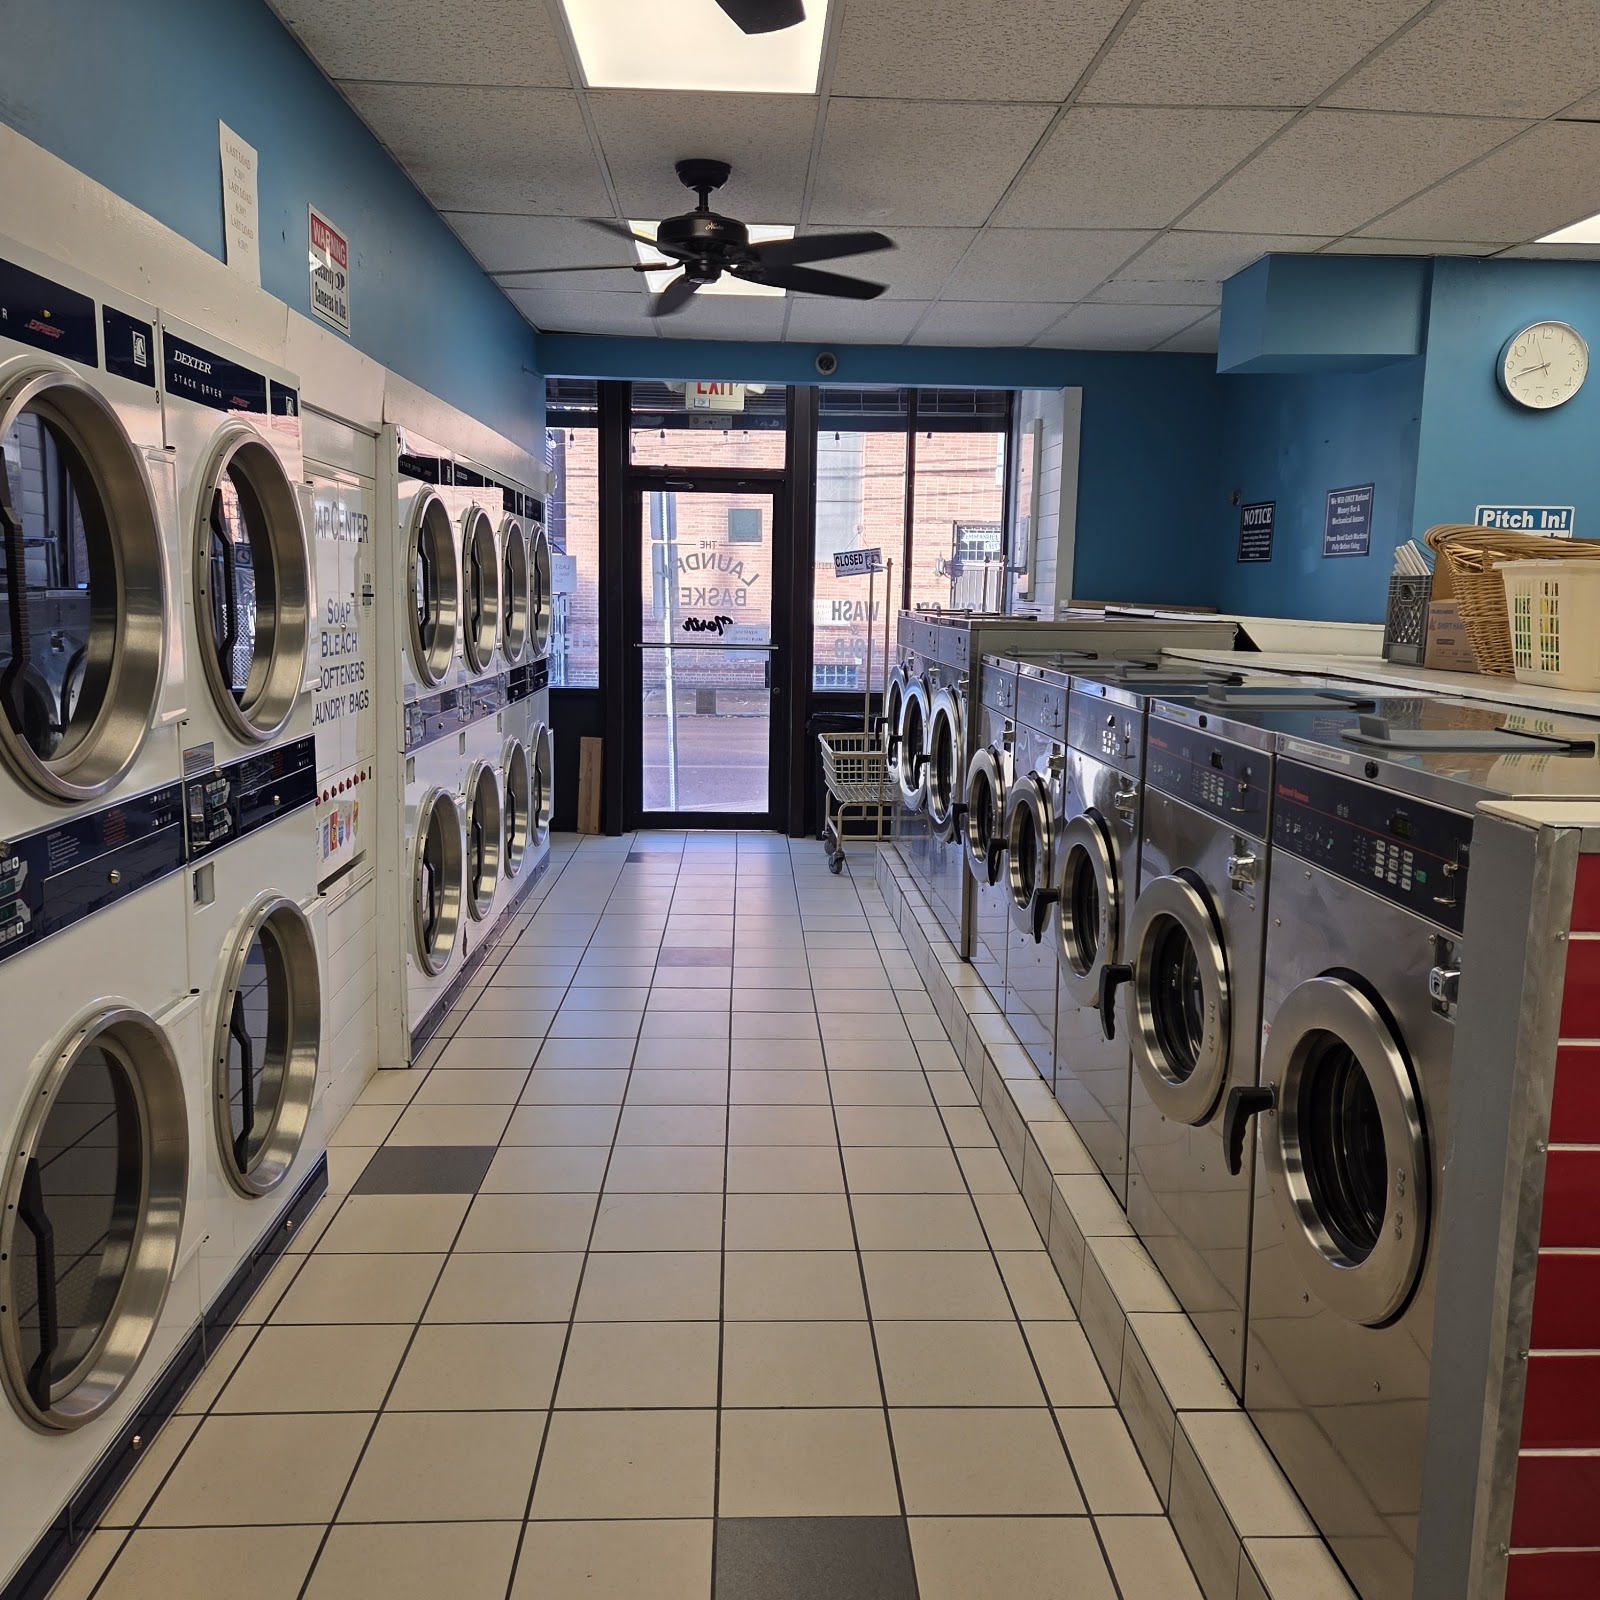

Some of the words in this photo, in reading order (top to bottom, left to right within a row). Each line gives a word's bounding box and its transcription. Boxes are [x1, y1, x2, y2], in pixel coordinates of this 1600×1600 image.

[226, 142, 238, 159] LAST
[238, 152, 251, 170] LOAD
[228, 178, 239, 196] LAST
[240, 188, 252, 205] LOAD
[231, 214, 241, 231] LAST
[241, 223, 254, 240] LOAD
[312, 220, 346, 265] WARNING
[315, 281, 334, 312] Cameras
[339, 298, 347, 320] Use
[1527, 333, 1536, 344] 11
[1542, 327, 1554, 340] 12
[1514, 345, 1527, 358] 10
[1568, 343, 1577, 355] 2
[173, 350, 212, 374] DEXTER
[1572, 360, 1580, 371] 3
[174, 373, 197, 389] STACK
[201, 383, 222, 399] DRYER
[1510, 376, 1517, 388] 8
[1564, 376, 1572, 387] 4
[156, 390, 160, 404] 8
[1522, 388, 1529, 399] 7
[1535, 395, 1543, 404] 6
[1552, 388, 1559, 400] 5
[1345, 495, 1355, 503] ONLY
[1355, 493, 1369, 502] Refund
[1243, 507, 1273, 525] NOTICE
[1337, 507, 1350, 515] Money
[330, 501, 369, 544] CENTER
[1332, 517, 1352, 525] Mechanical
[1482, 509, 1534, 528] Pitch
[1541, 510, 1567, 529] In!
[835, 553, 864, 567] CLOSED
[327, 598, 351, 624] SOAP
[321, 631, 358, 658] BLEACH
[313, 695, 346, 726] AUNDRY
[349, 689, 369, 714] BAGS
